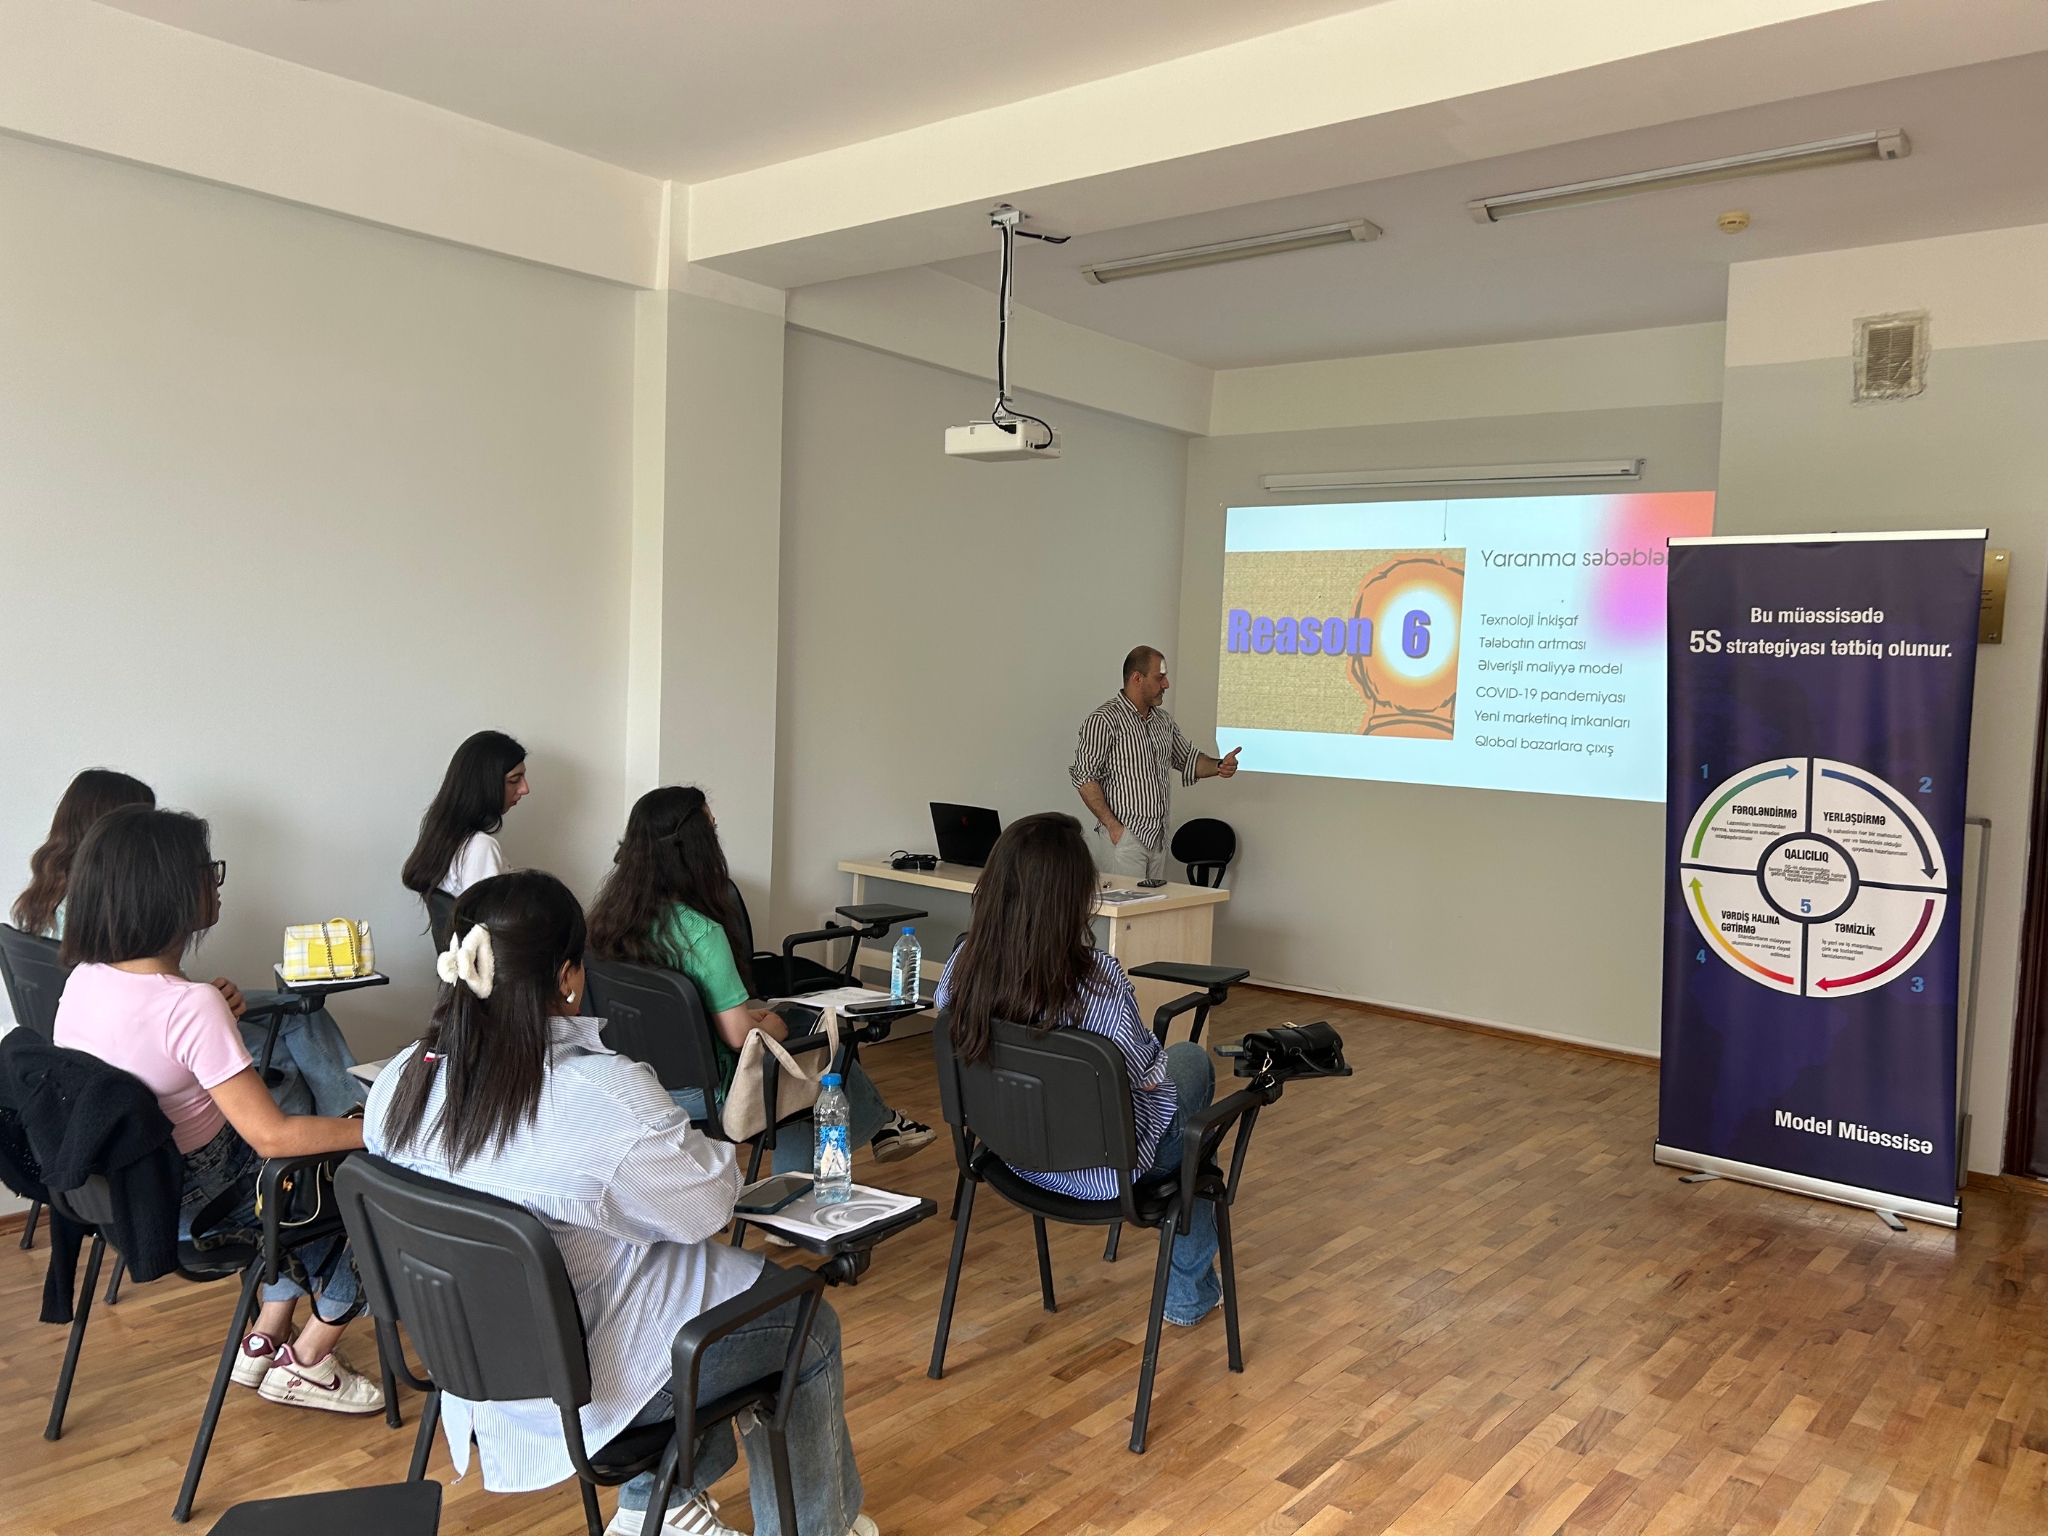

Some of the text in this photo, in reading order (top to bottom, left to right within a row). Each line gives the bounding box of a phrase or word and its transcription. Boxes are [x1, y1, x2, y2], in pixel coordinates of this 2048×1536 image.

[1481, 549, 1576, 567] Yaranma
[1480, 611, 1579, 629] Texnoloji İnkişaf
[1750, 606, 1884, 624] Bu müəssisədə
[1226, 608, 1431, 658] Reason 6
[1479, 636, 1586, 650] Tələbatın artması
[1689, 629, 1953, 659] 5S strategiyası tətbiq olunur.
[1478, 659, 1622, 676] Əlverişli maliyyə model
[1476, 686, 1626, 705] COVID-19 pandemiyası
[1474, 710, 1630, 728] Yeni marketinq imkanları
[1474, 735, 1614, 757] Qlobal bazarlara çıxış
[1700, 763, 1709, 779] 1
[1918, 776, 1933, 793] 2
[1732, 805, 1798, 819] FƏRQLƏNDİRMƏ
[1823, 811, 1886, 826] YERLƏŞDİRMƏ
[1784, 848, 1829, 863] QALICILIQ
[1800, 898, 1812, 914] 5
[1721, 910, 1780, 925] VƏRDİŞ HALINA
[1721, 922, 1756, 934] GƏTİRMƏ
[1835, 922, 1876, 936] TƏMİZLİK
[1696, 949, 1707, 964] 4
[1910, 976, 1925, 993] 3
[1775, 1109, 1933, 1155] Model Müəssisə
